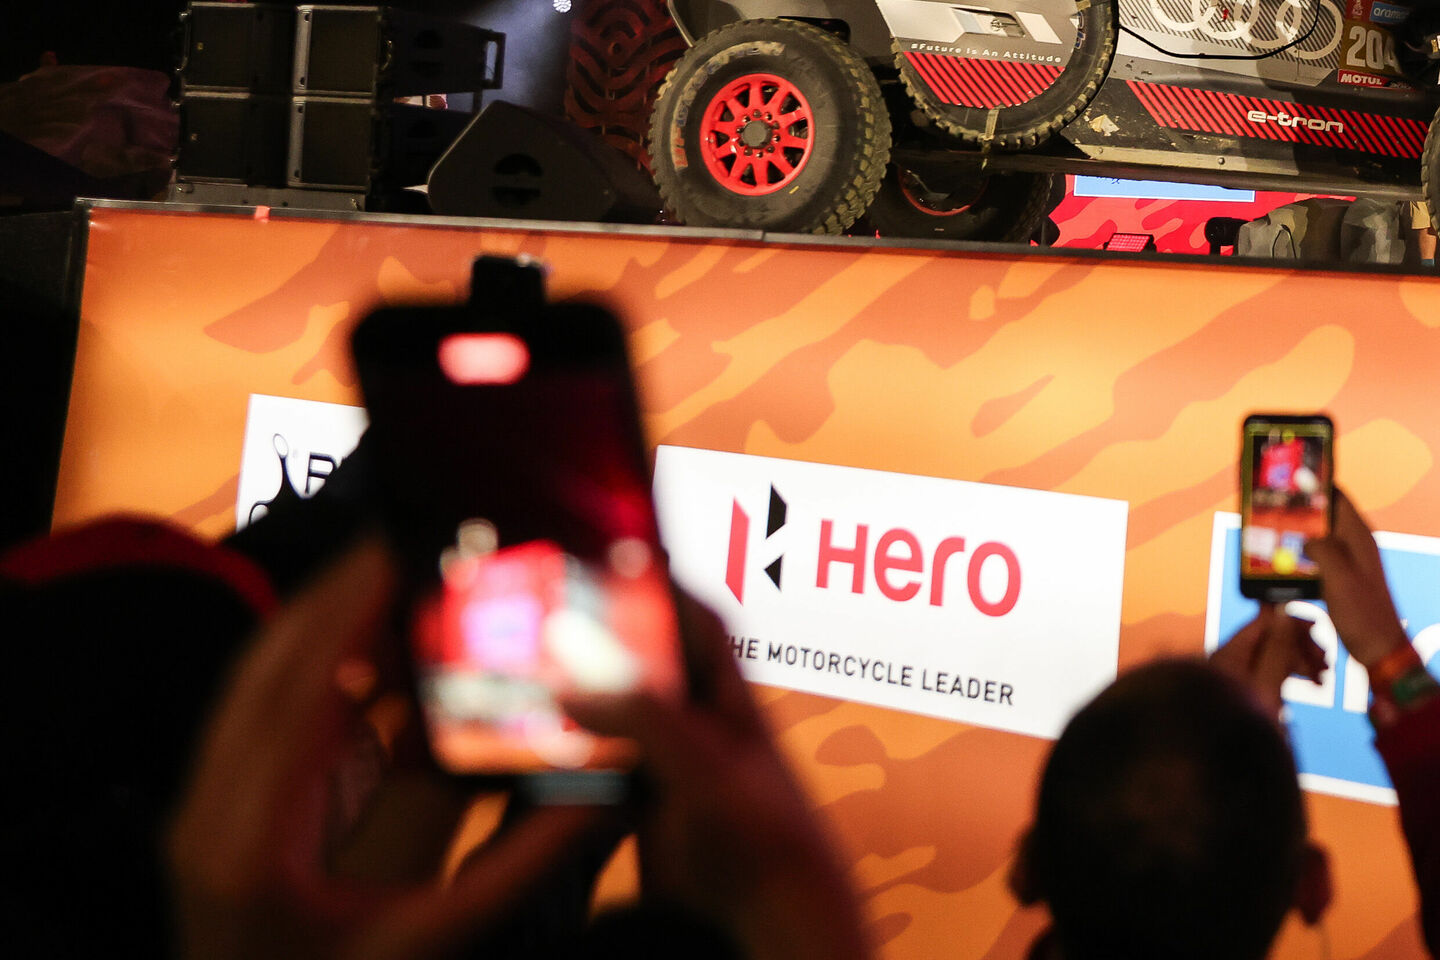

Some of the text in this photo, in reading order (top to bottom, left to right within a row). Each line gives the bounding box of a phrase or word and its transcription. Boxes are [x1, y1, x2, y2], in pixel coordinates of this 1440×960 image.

[1373, 6, 1410, 20] aram
[911, 43, 961, 54] #Future
[982, 49, 998, 57] An
[1003, 51, 1062, 63] Attitude
[1340, 73, 1382, 85] MOTUL
[1247, 110, 1344, 133] e-tron
[816, 518, 1022, 618] Hero
[730, 636, 1014, 705] HE MOTORCYCLE LEADER
